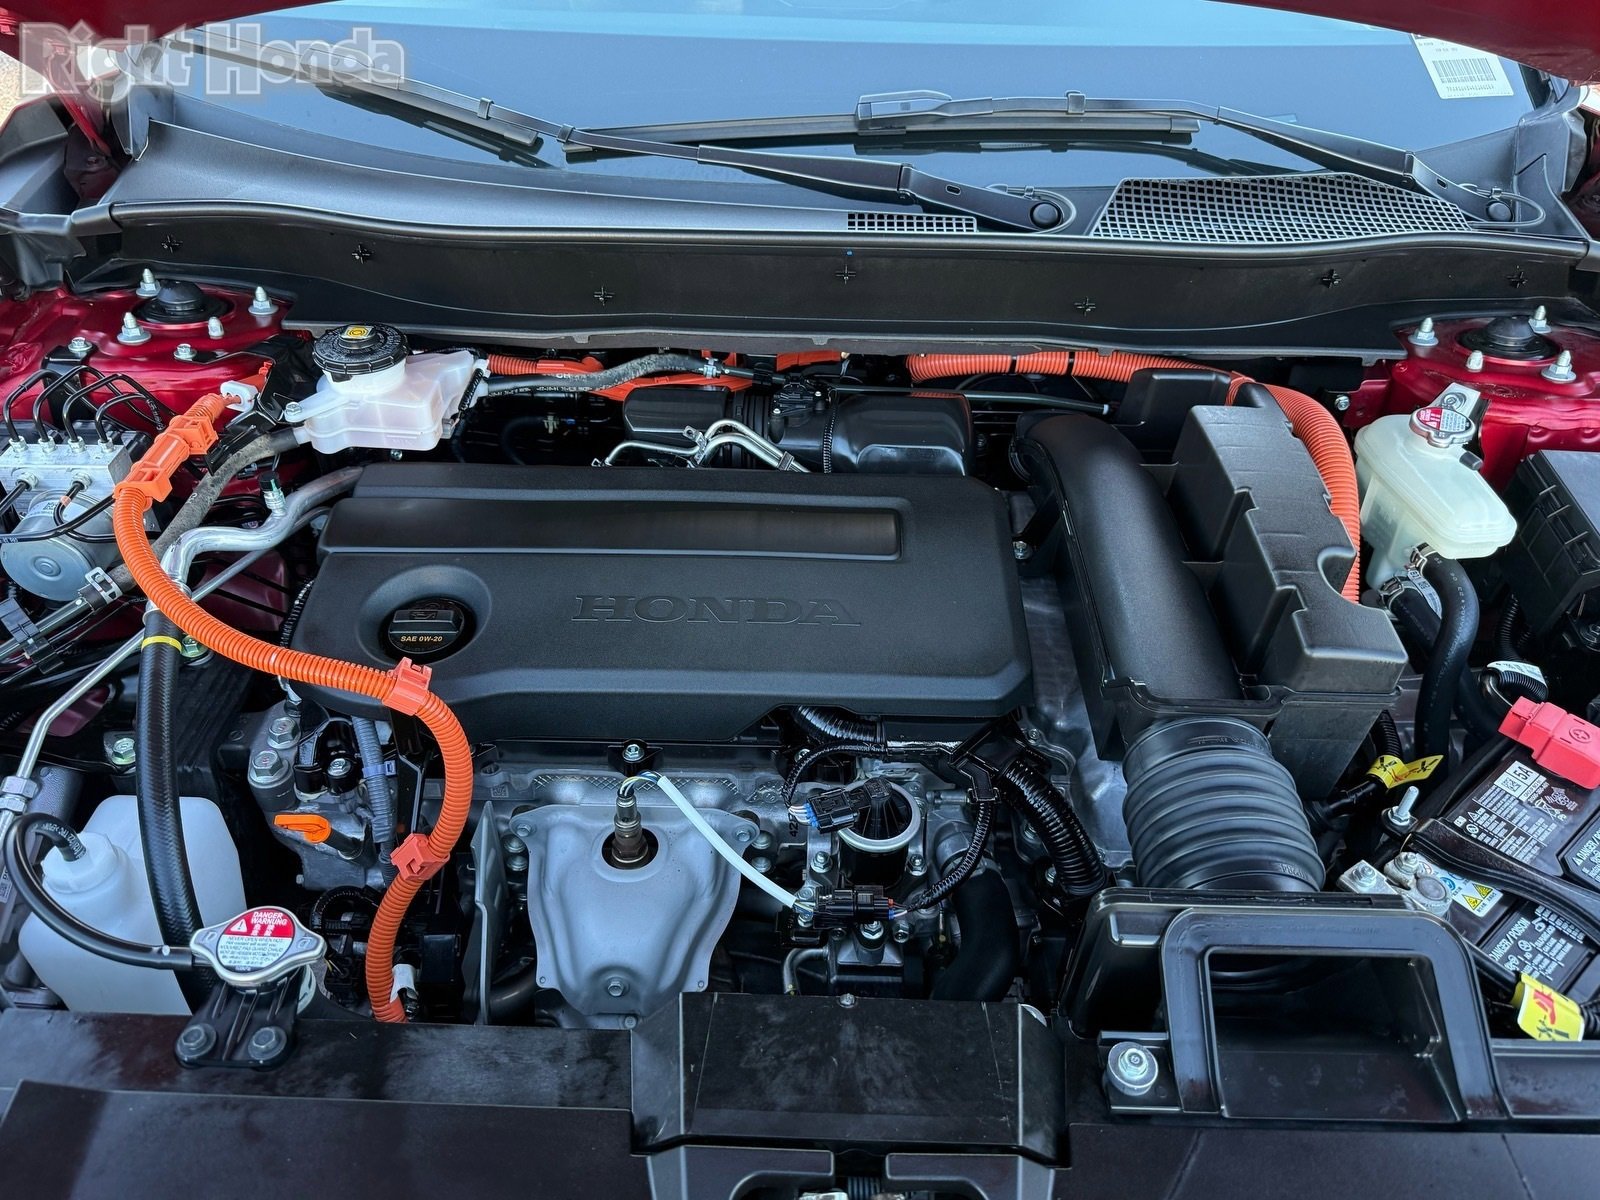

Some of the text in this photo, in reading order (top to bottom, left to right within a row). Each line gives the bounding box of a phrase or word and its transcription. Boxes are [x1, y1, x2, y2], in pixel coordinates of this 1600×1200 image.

[571, 596, 862, 627] HONDA
[1513, 766, 1533, 780] 5A
[252, 911, 284, 920] DANGER
[251, 918, 288, 926] WARNUNG
